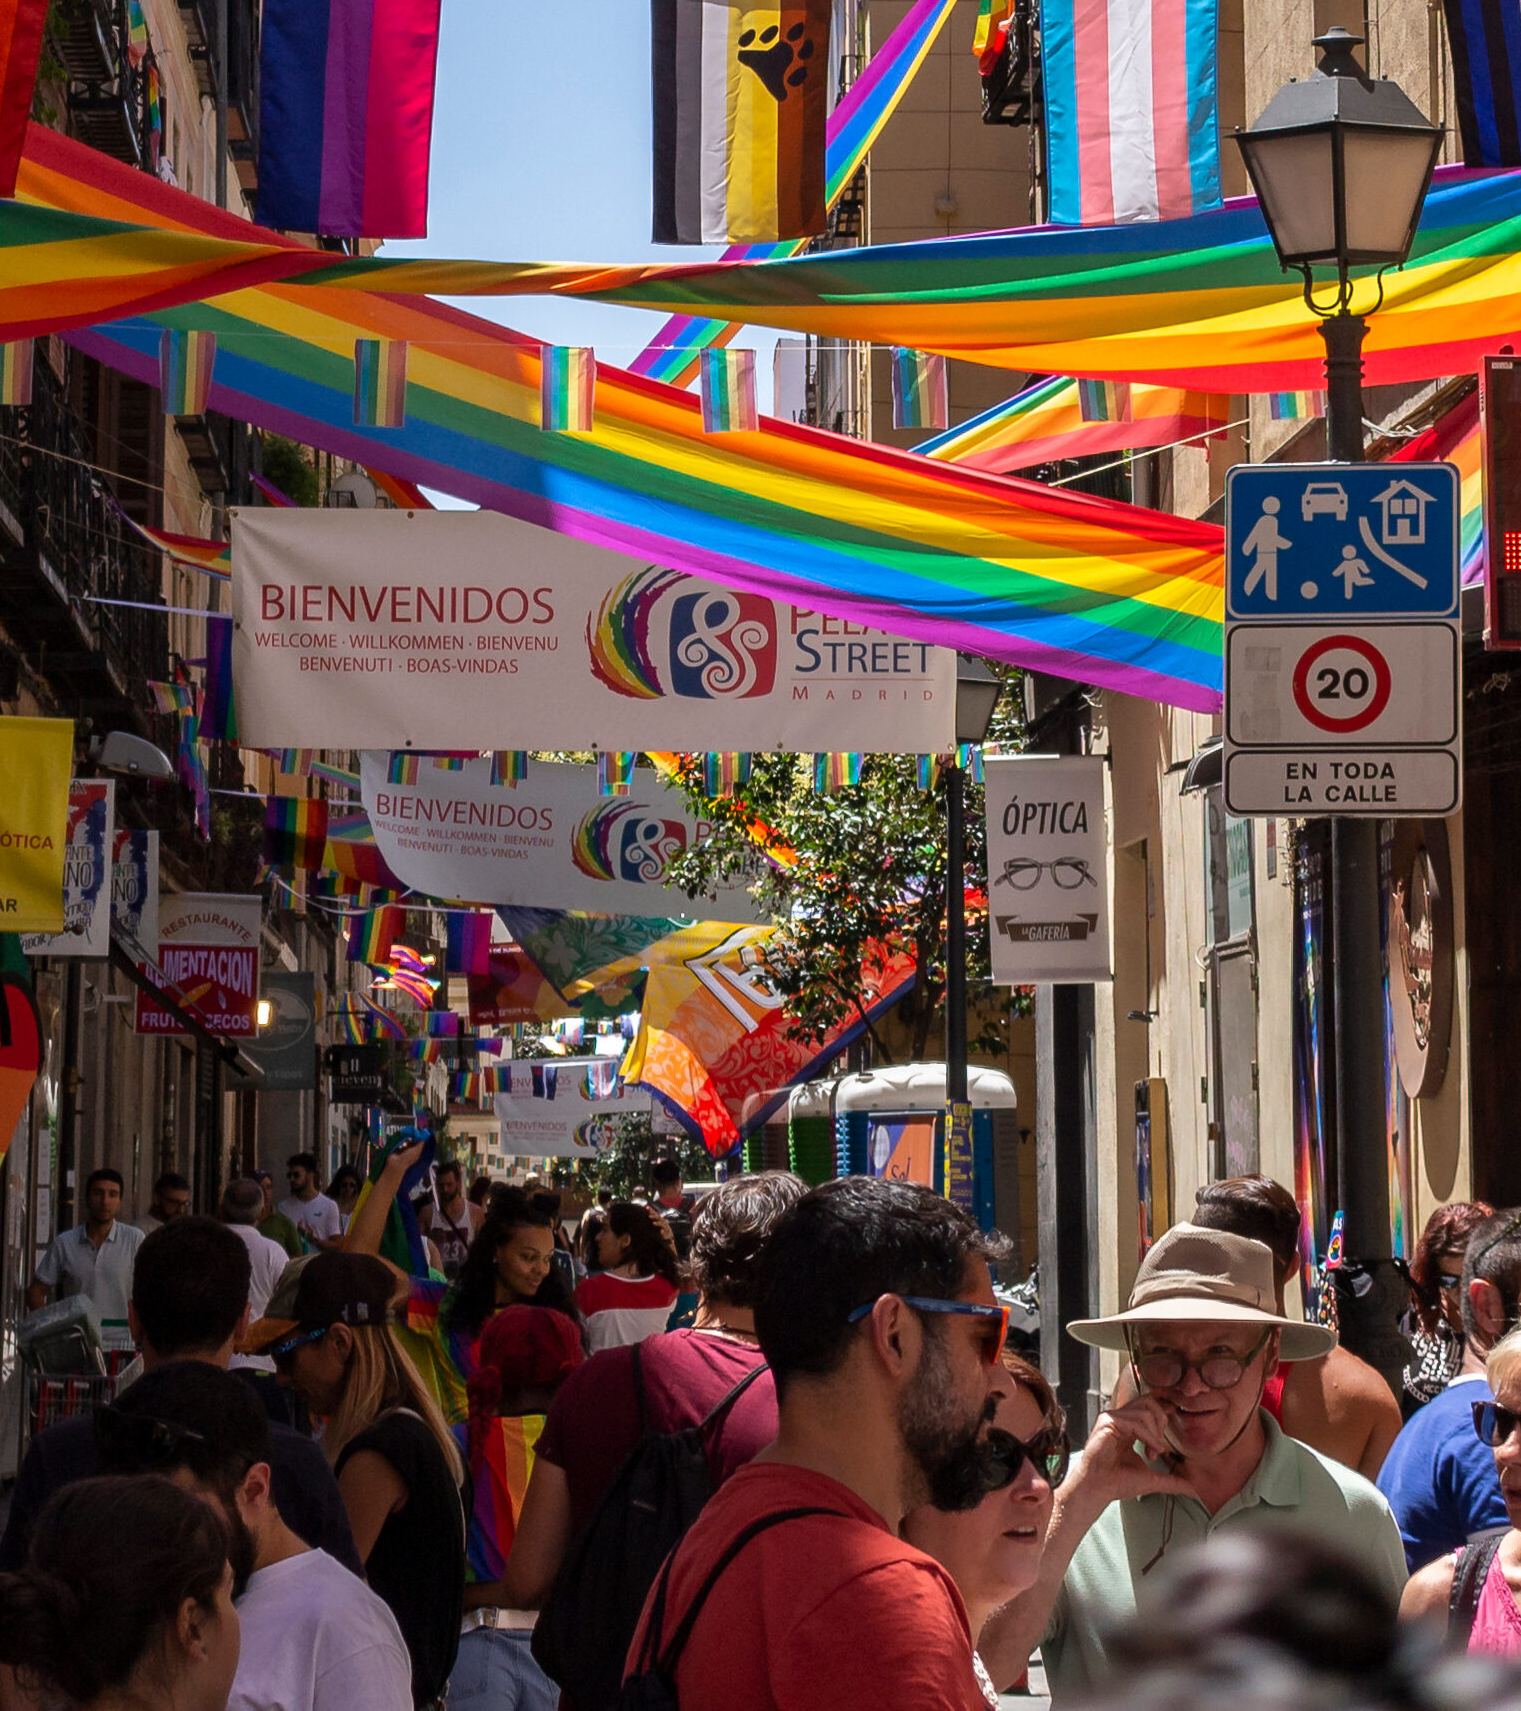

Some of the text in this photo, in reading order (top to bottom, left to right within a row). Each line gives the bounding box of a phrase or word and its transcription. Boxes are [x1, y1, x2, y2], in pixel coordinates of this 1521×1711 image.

[260, 584, 555, 625] BIENVENIDOS
[254, 632, 560, 652] WELCOME WILLKOMMEN BIENVENU
[794, 628, 936, 673] STREET
[299, 656, 520, 674] BENVENUTI BOAS-VINDAS
[1316, 667, 1370, 700] 20
[1285, 762, 1396, 780] EN TODA
[1283, 784, 1398, 803] LA CALLE
[375, 793, 555, 832] BIENVENIDOS
[1002, 794, 1089, 836] ÓPTICA
[397, 837, 453, 856] BENVENUTI
[426, 827, 498, 845] WILLKOMMEN
[504, 834, 555, 849] BIENVENU
[161, 911, 253, 943] RESTAURANTE
[1028, 922, 1071, 941] GAFERÍA
